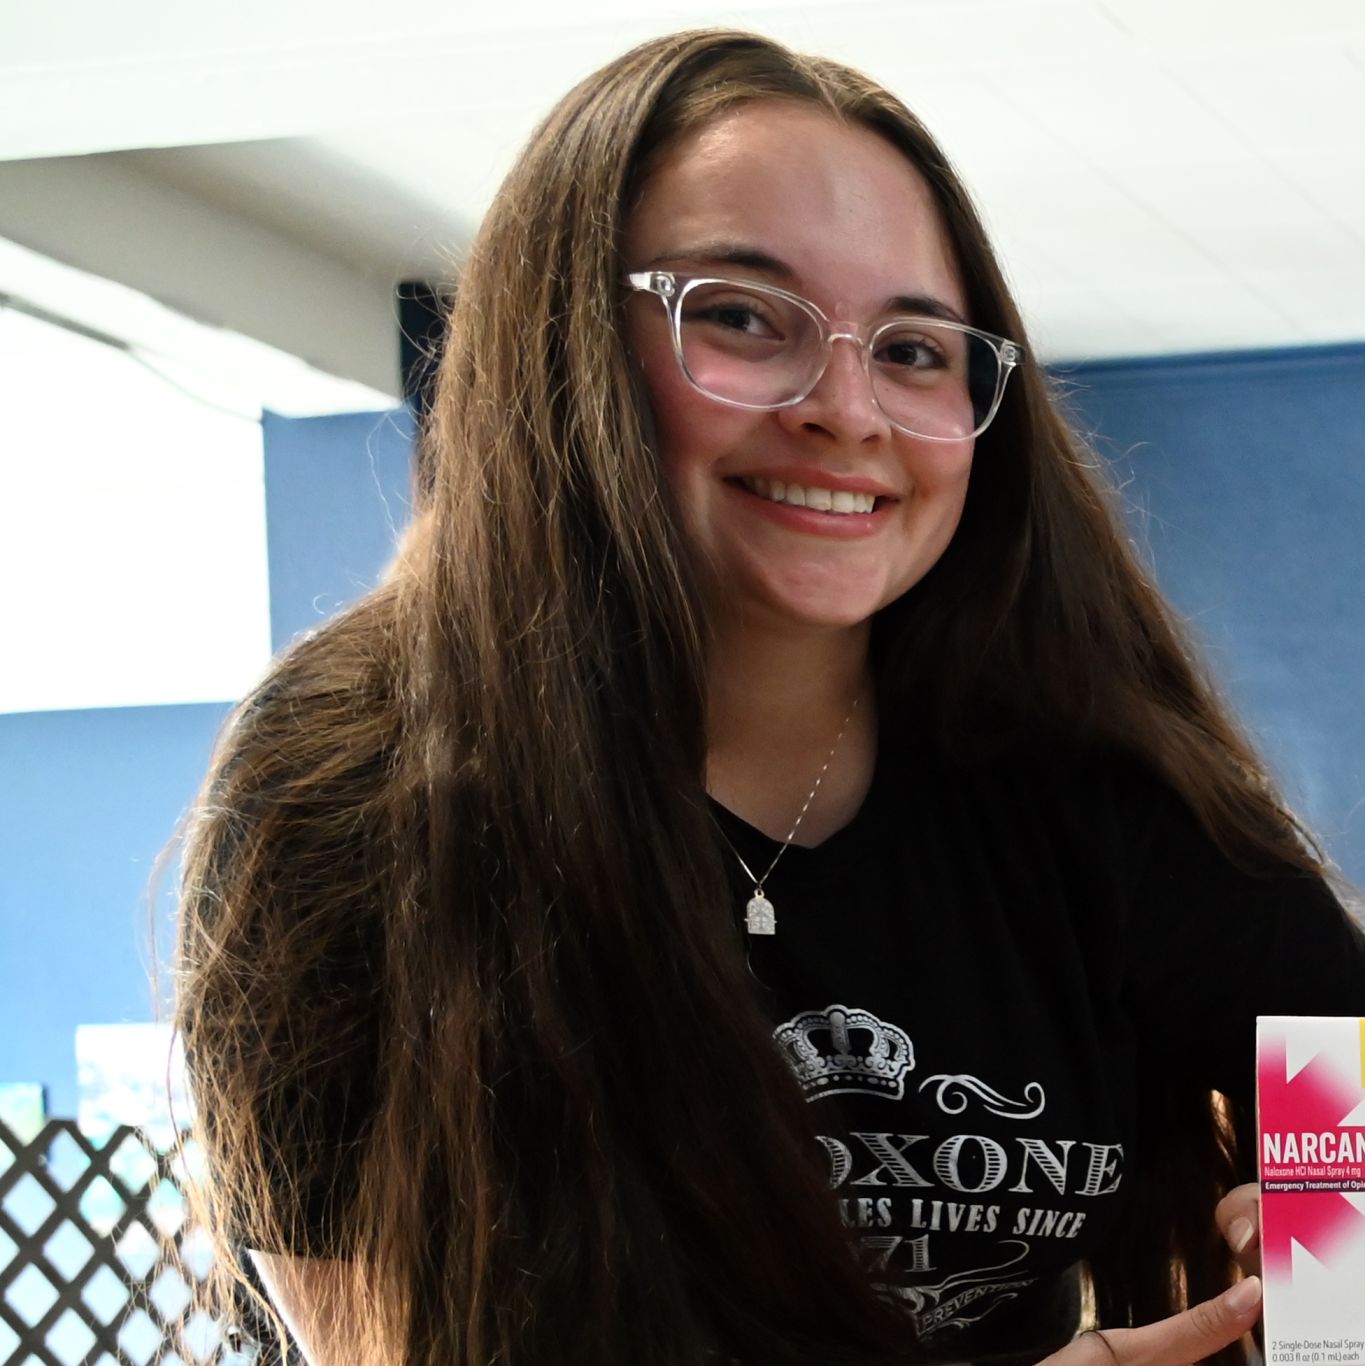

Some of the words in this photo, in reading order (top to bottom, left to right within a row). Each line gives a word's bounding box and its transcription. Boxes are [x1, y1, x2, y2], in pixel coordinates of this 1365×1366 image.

[814, 1131, 1125, 1197] OXONE
[1264, 1166, 1294, 1177] Naloxone
[1307, 1166, 1326, 1176] Nasal
[1327, 1166, 1345, 1178] Spray
[1346, 1166, 1350, 1176] 4
[1351, 1167, 1361, 1178] mg
[1265, 1181, 1304, 1191] Emergency
[1305, 1180, 1341, 1189] Treatment
[1342, 1180, 1350, 1189] of
[910, 1198, 1000, 1232] LIVES
[1012, 1207, 1087, 1239] SINCE
[858, 1234, 937, 1273] 71
[920, 1278, 1038, 1329] PREVENT
[1272, 1341, 1277, 1350] 2
[1278, 1340, 1322, 1351] Single-Dose
[1322, 1339, 1343, 1349] Nasal
[1344, 1339, 1365, 1351] Spray
[1272, 1353, 1295, 1362] 0.003
[1342, 1352, 1360, 1361] each
